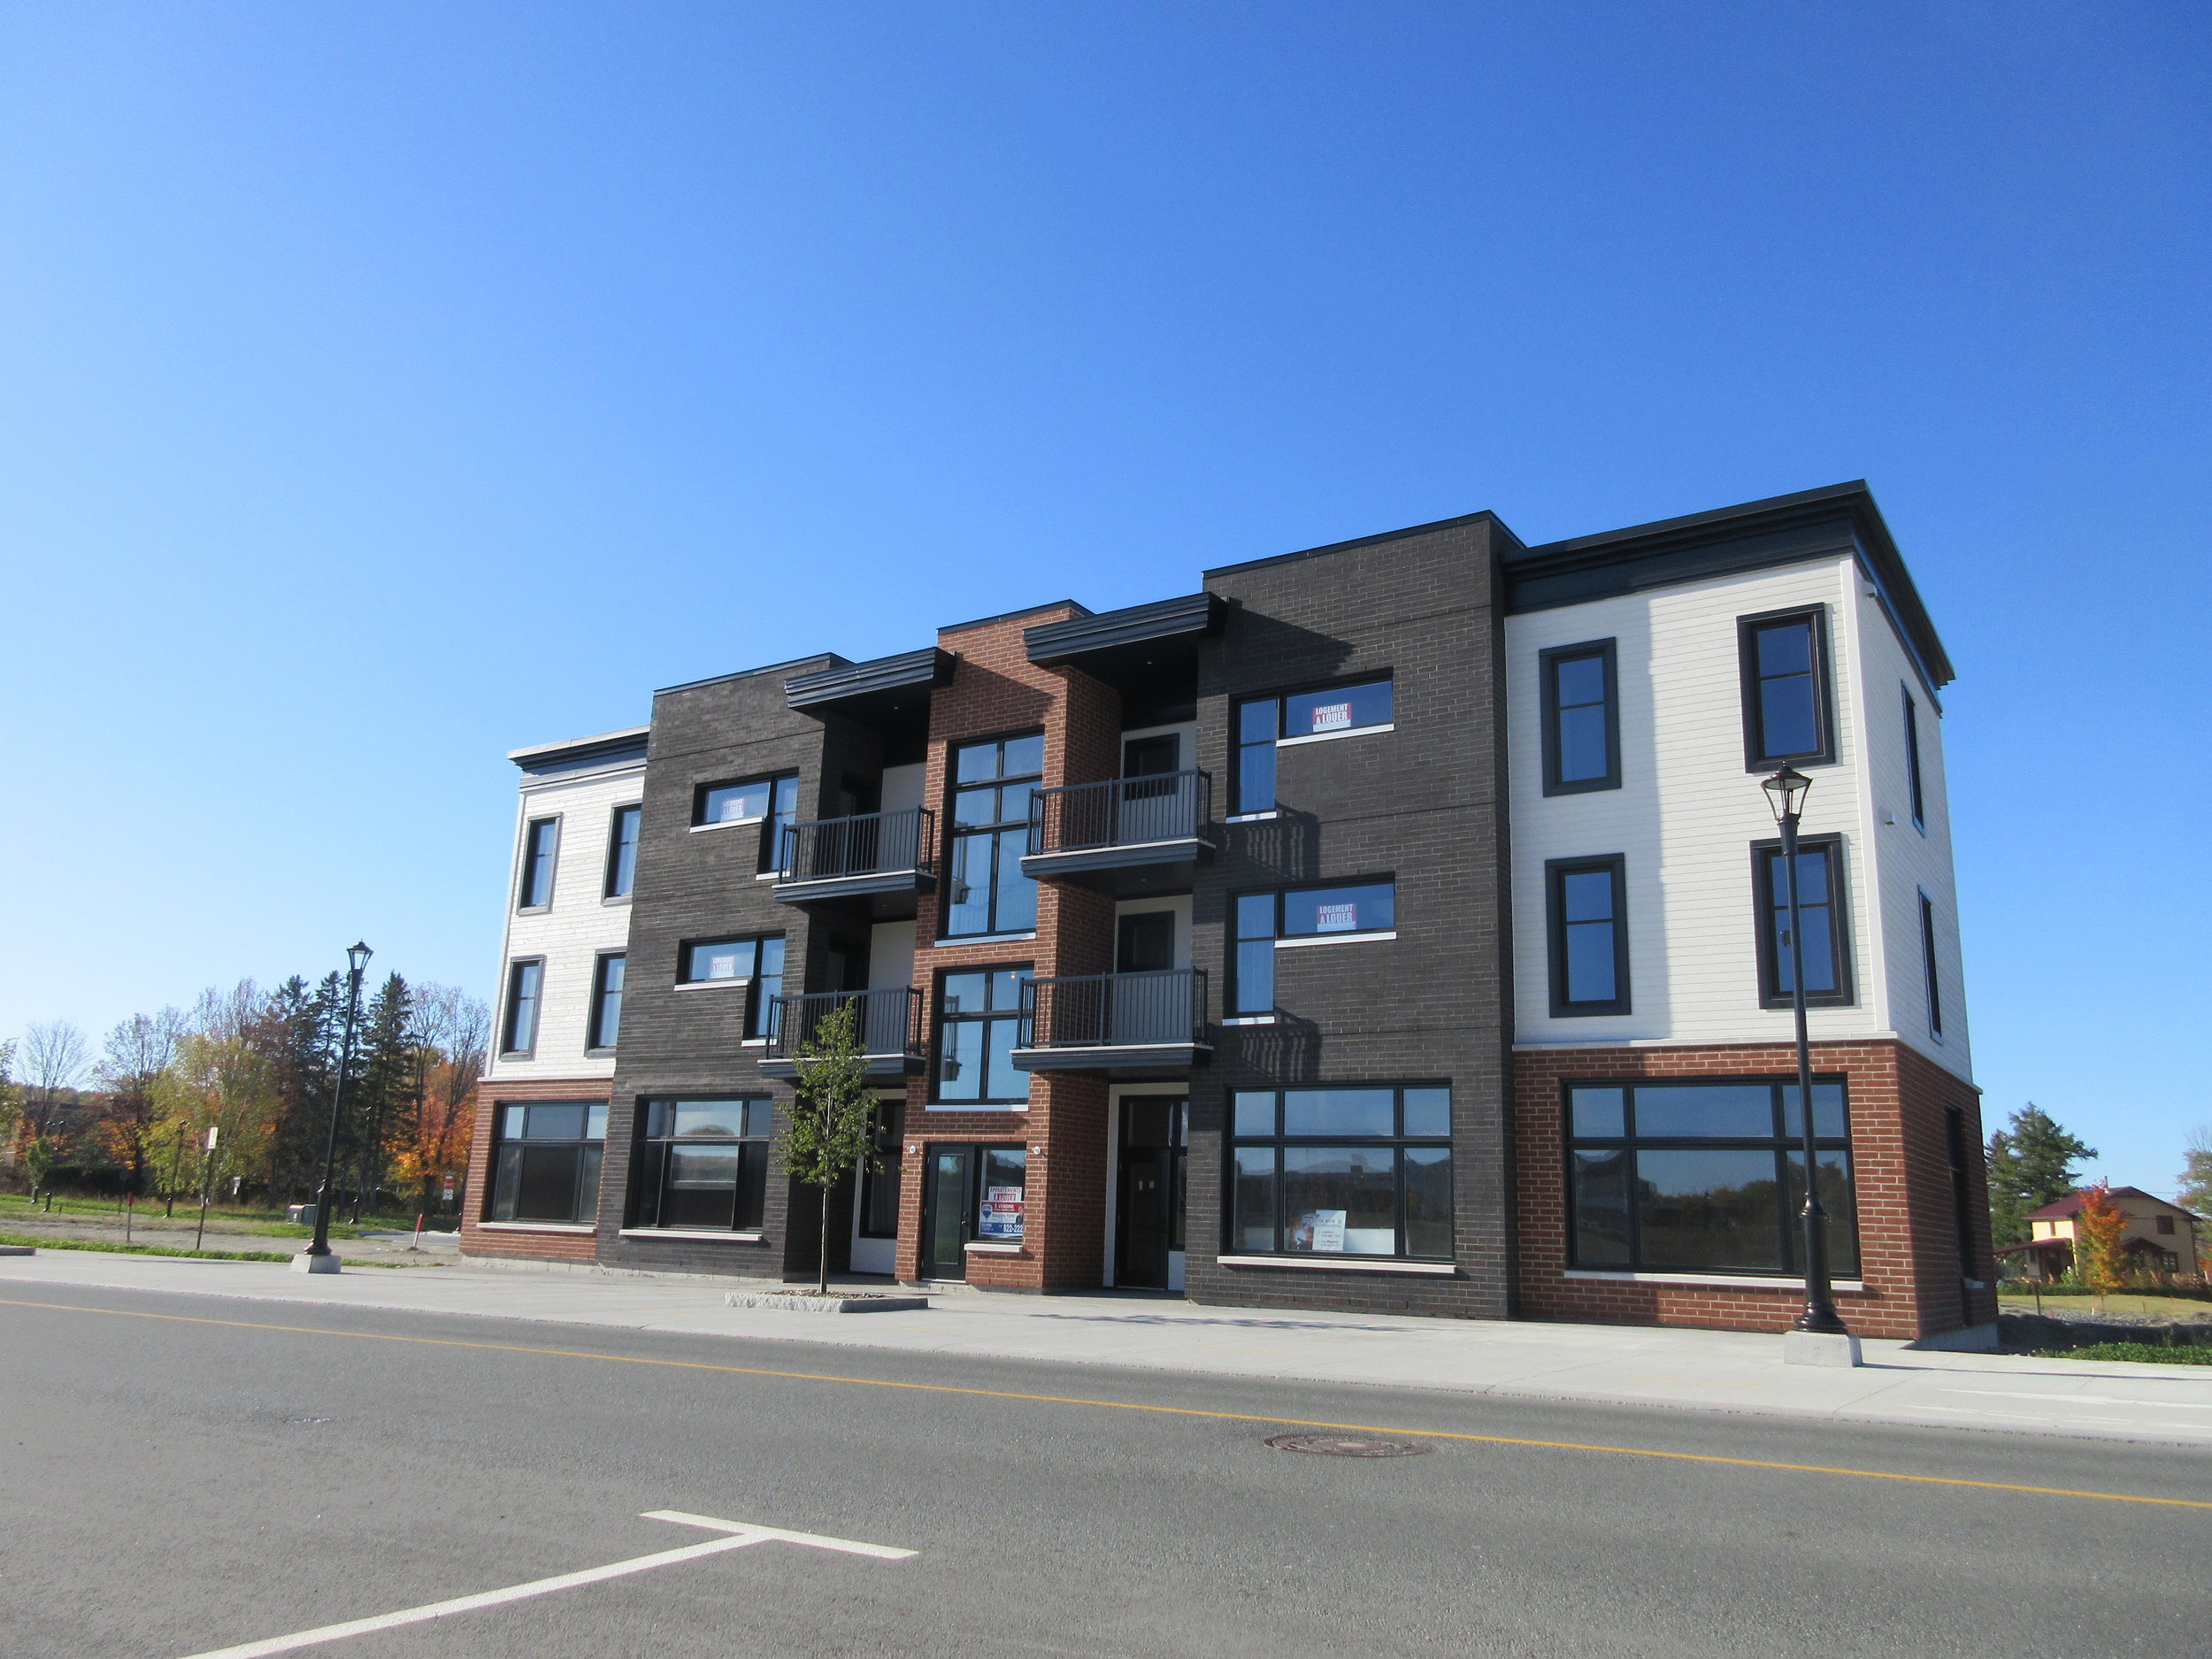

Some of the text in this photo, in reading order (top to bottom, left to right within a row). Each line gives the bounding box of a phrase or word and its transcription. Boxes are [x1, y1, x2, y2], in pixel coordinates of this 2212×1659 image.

[1316, 703, 1348, 715] LOGEMENT
[1322, 710, 1348, 724] LOUER
[1319, 903, 1354, 914] LOGEMENT
[1326, 911, 1353, 924] LOUER
